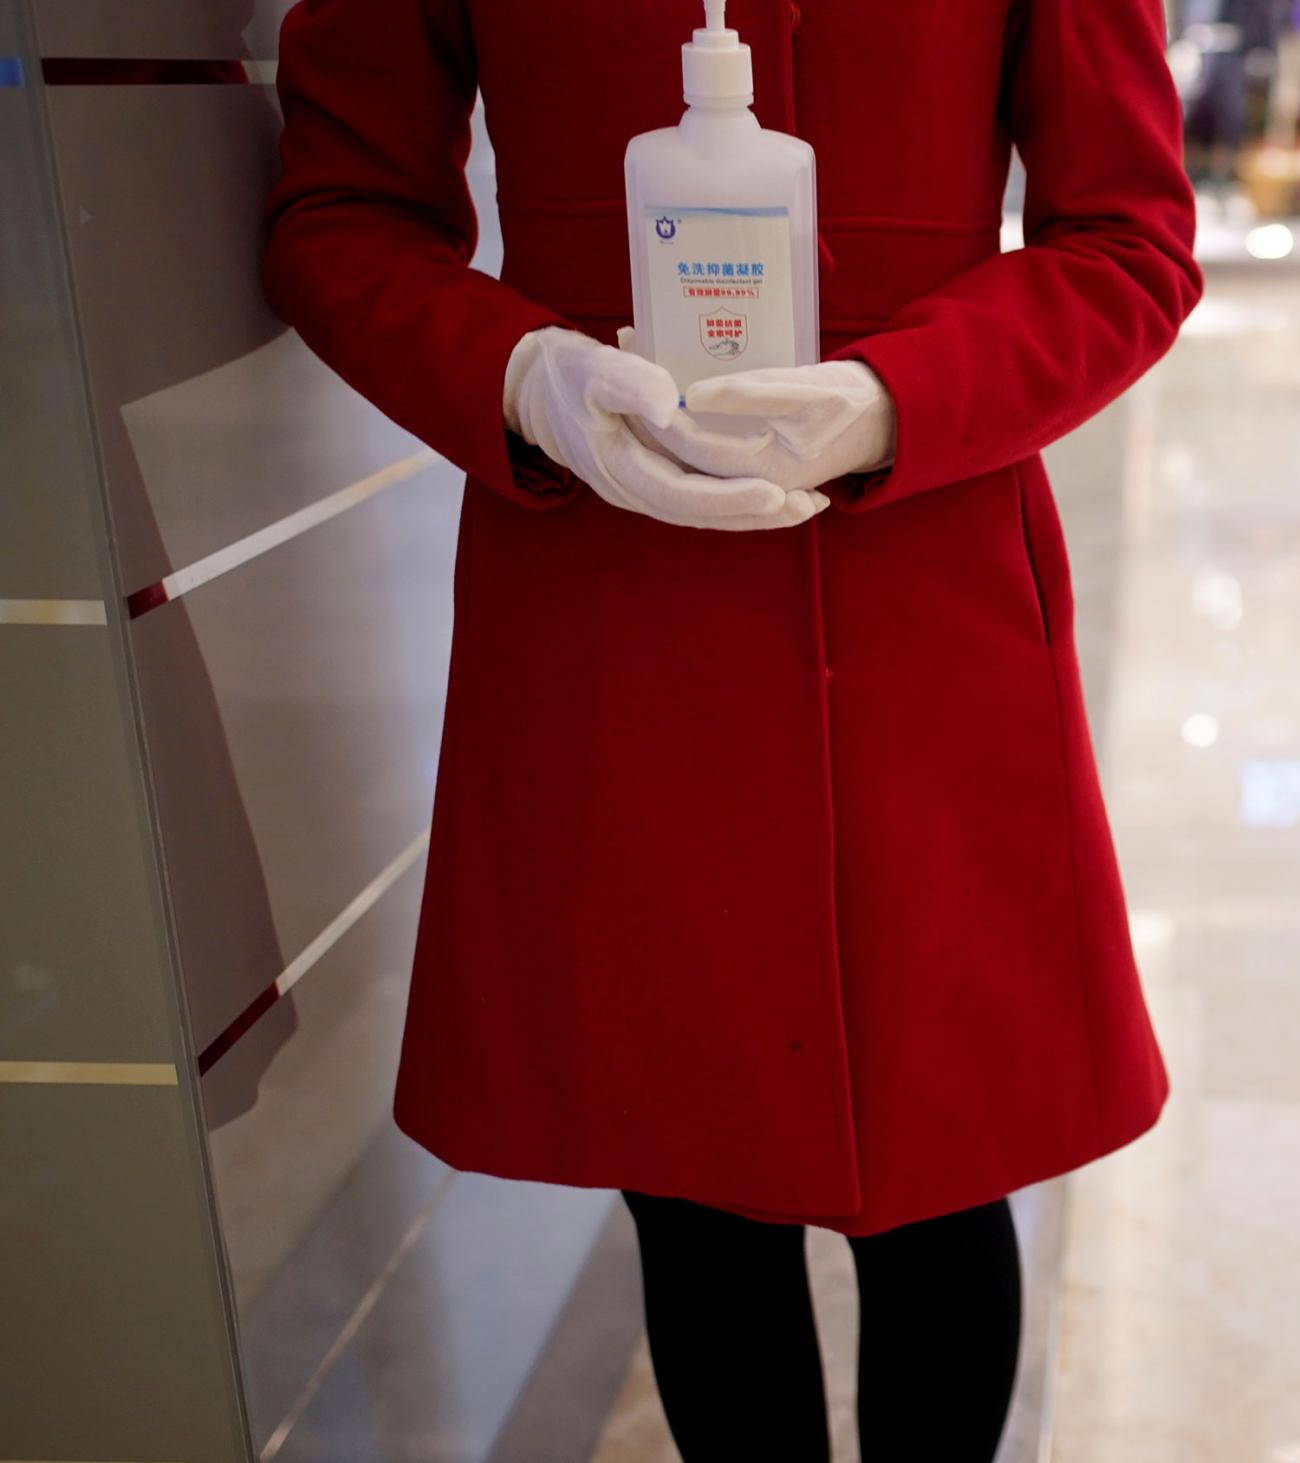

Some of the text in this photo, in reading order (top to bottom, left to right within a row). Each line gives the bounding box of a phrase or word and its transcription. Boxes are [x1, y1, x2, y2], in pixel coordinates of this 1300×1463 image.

[678, 262, 763, 276] 免洗抑菌凝胶
